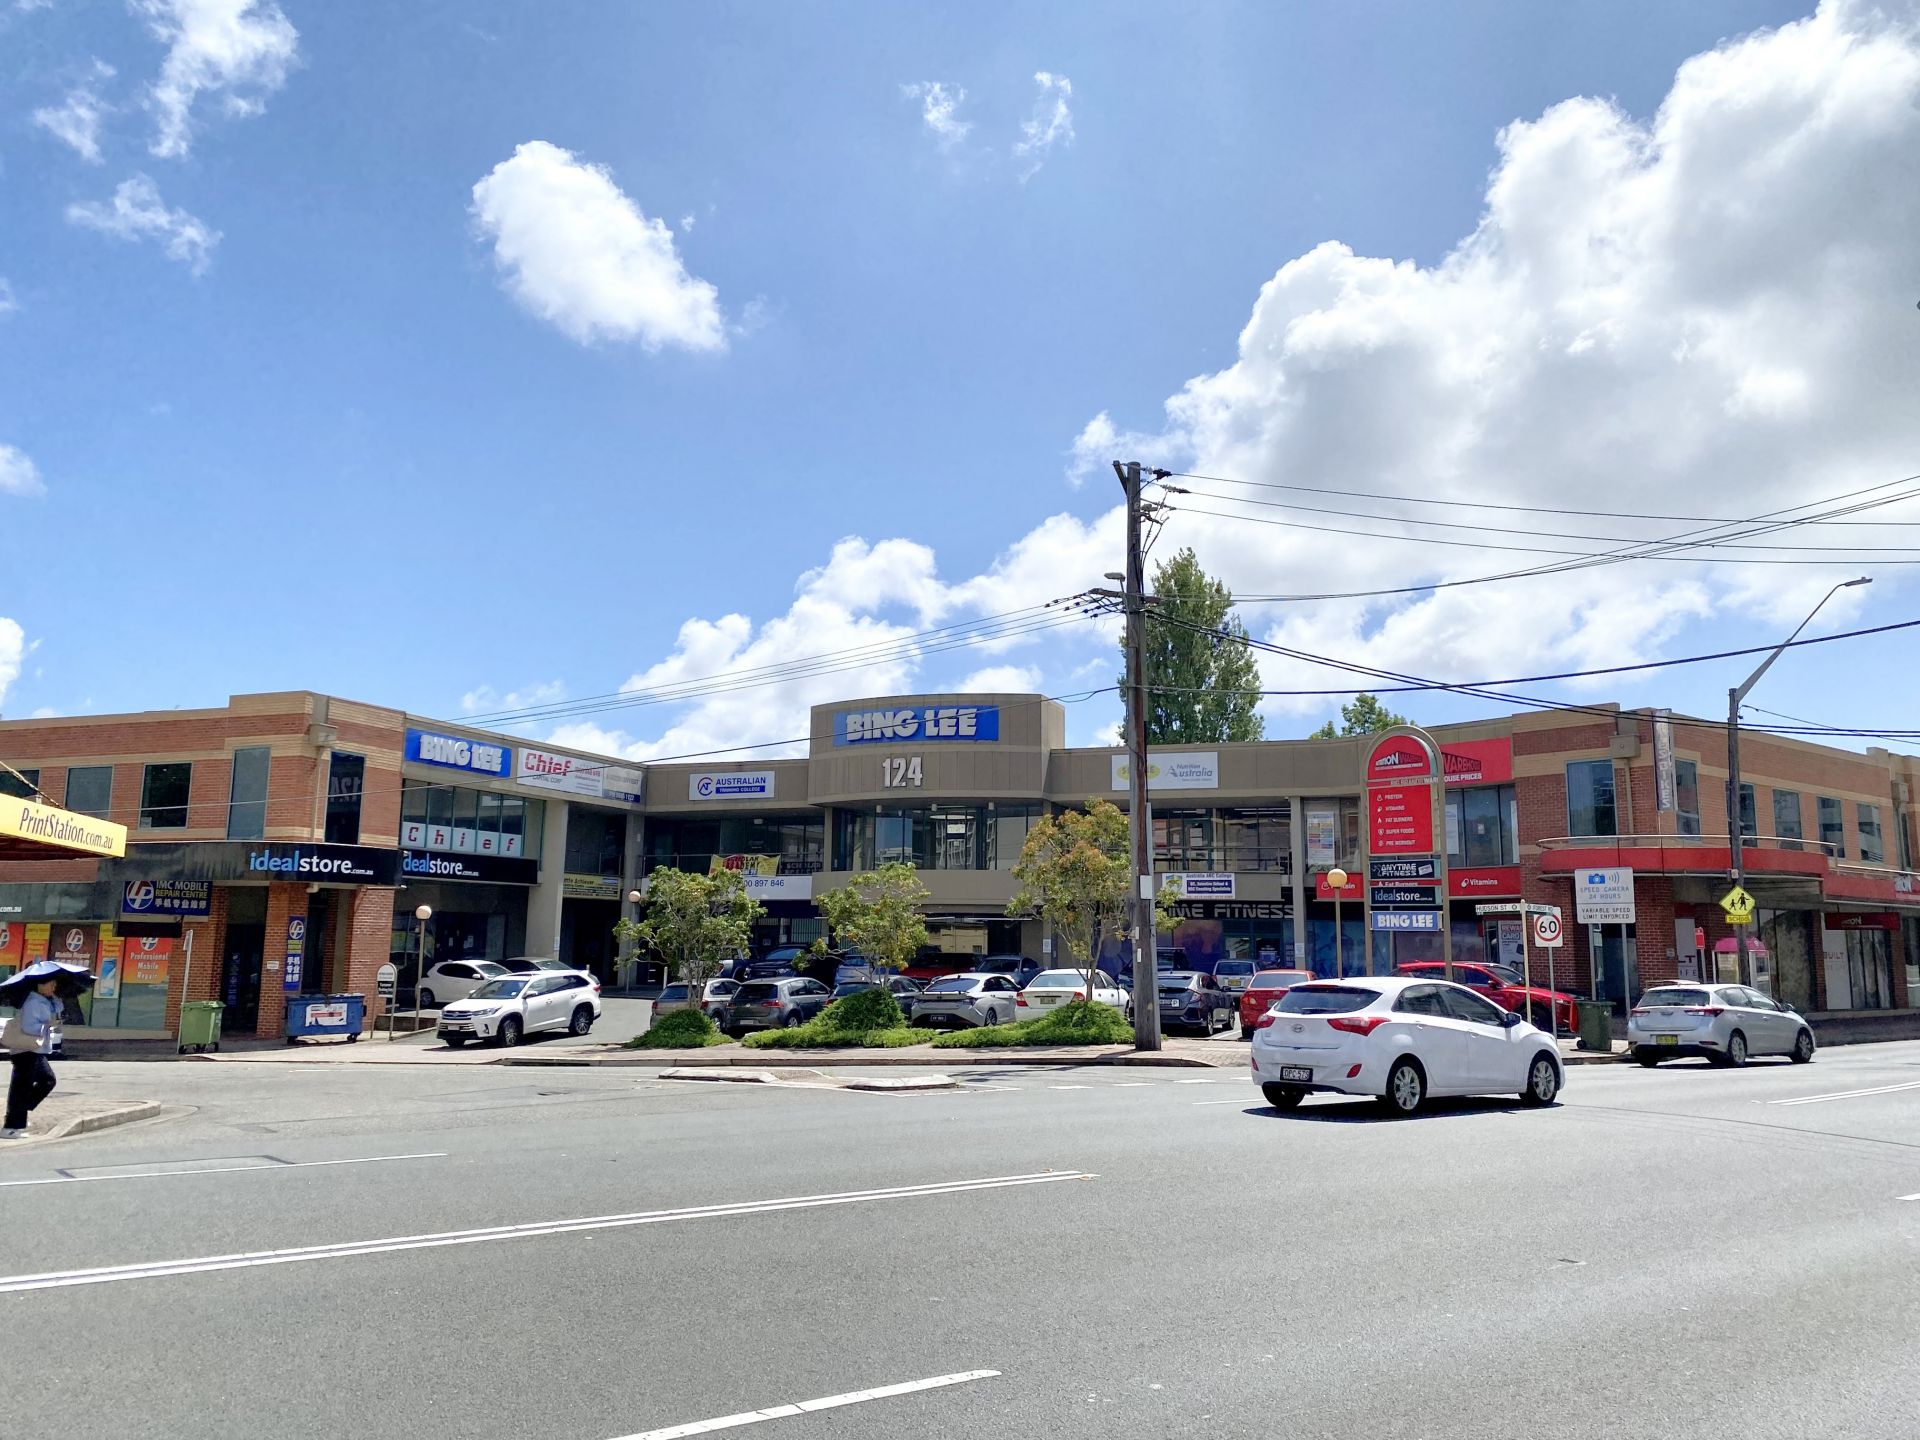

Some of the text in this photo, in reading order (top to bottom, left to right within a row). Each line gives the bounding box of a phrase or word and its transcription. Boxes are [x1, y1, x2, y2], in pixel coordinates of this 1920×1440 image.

[846, 708, 978, 741] BING LEE
[420, 734, 502, 772] BING LEE
[524, 752, 572, 776] Chief
[882, 756, 923, 788] 124
[1424, 774, 1460, 784] WAROUSE
[716, 776, 766, 786] AUSTRALIAN
[20, 808, 114, 849] PrintStation.com.au
[174, 881, 208, 891] MOBILE
[156, 889, 180, 898] REPAIR
[1214, 904, 1294, 918] FITNESS
[1378, 914, 1433, 928] BING LEE
[1540, 920, 1557, 934] 60
[130, 952, 168, 960] Professional
